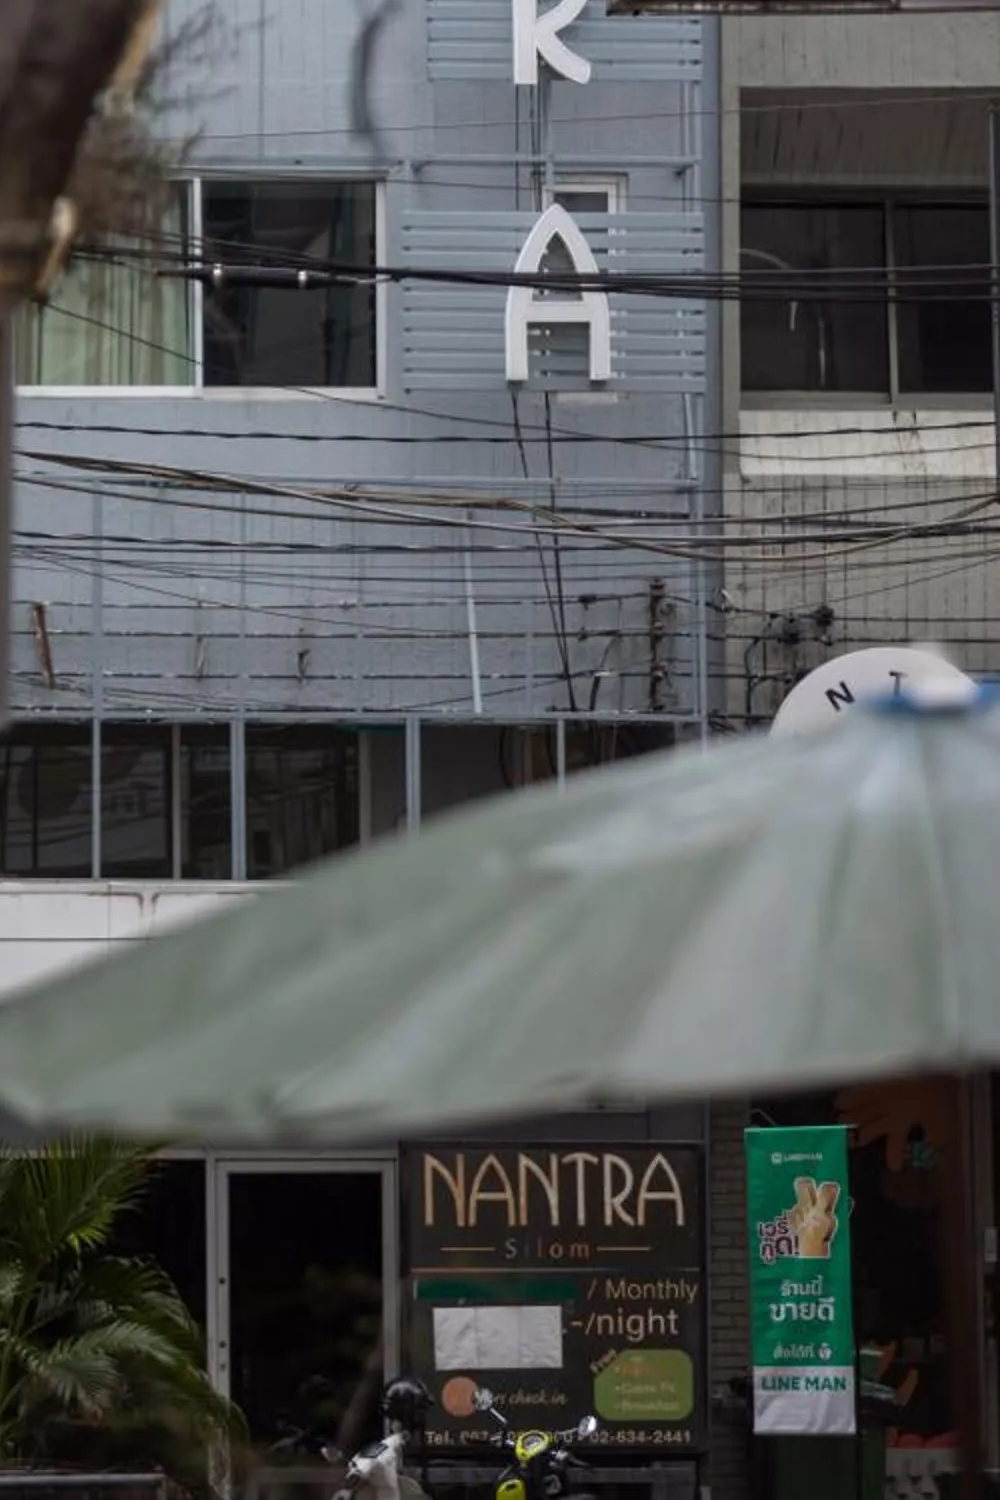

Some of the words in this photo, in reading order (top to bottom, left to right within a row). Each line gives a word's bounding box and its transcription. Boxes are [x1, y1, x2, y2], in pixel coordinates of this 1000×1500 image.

[423, 1153, 685, 1227] NANTRA
[605, 1277, 698, 1304] Monthly
[768, 1296, 836, 1322] ขายดี
[760, 1375, 801, 1391] LINE
[805, 1374, 847, 1391] MAN
